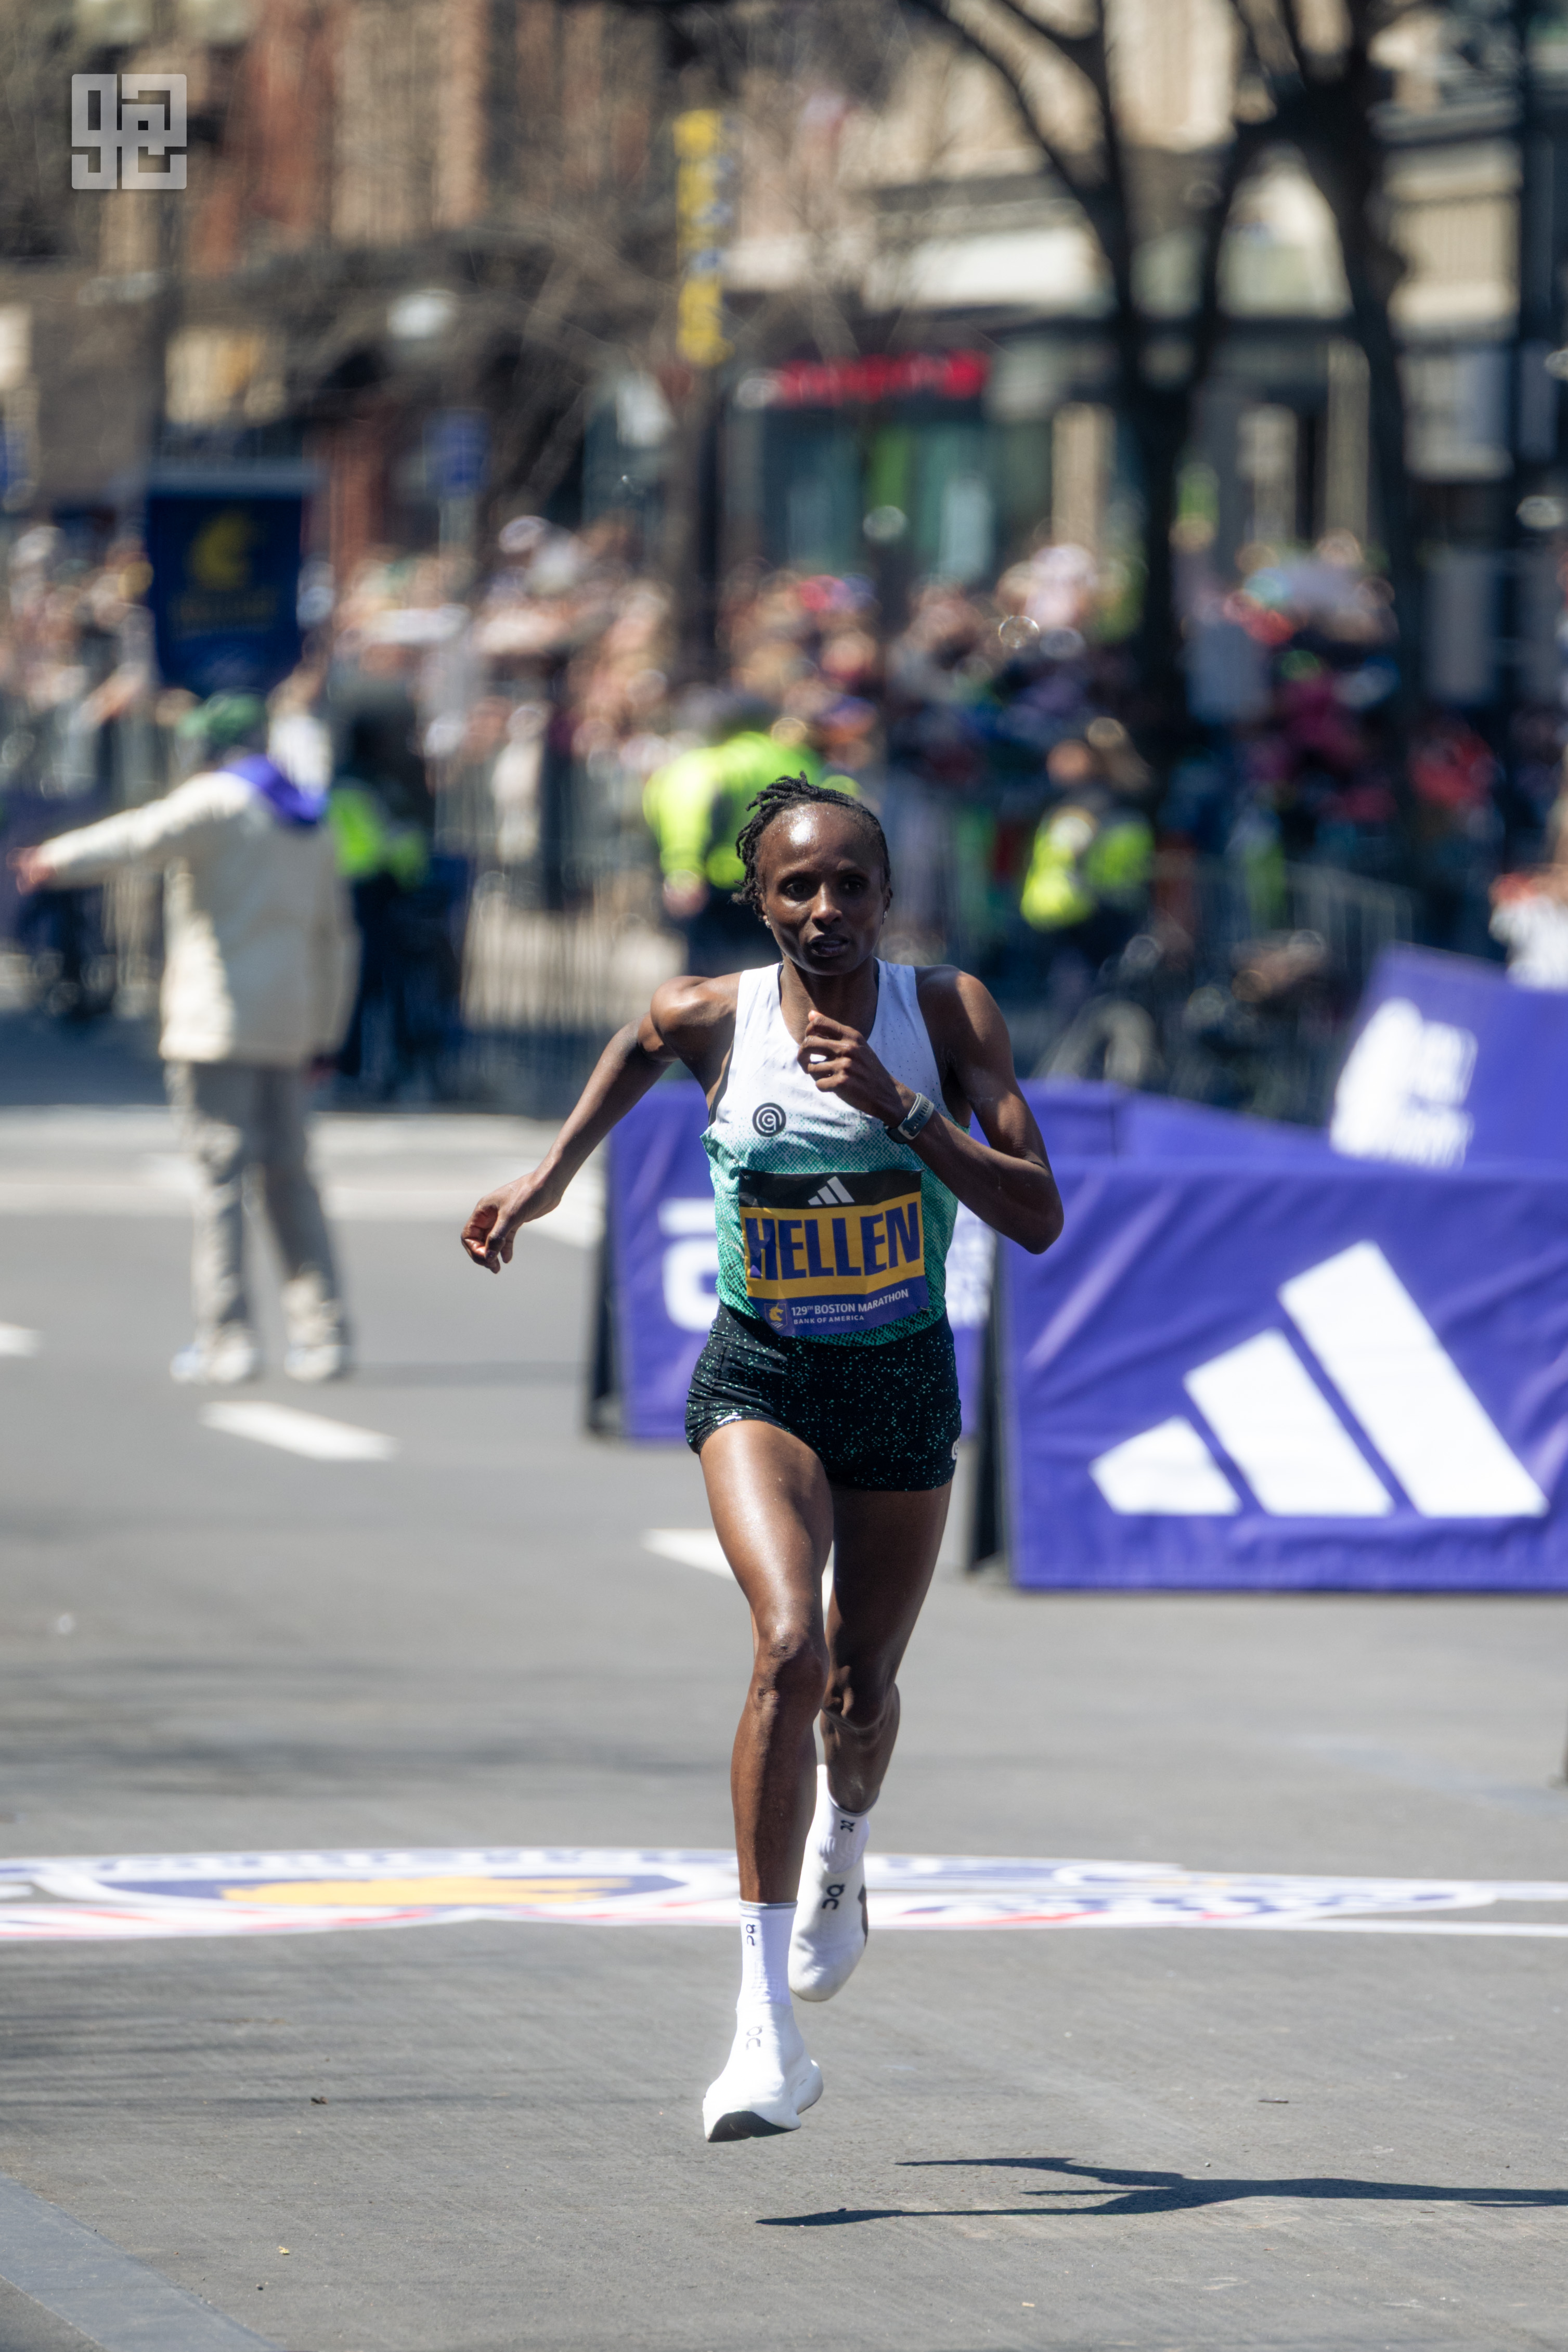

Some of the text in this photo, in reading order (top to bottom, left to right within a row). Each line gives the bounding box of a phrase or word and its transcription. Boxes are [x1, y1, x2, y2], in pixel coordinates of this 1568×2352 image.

[744, 1201, 921, 1281] HELLEN
[814, 1303, 856, 1315] BOSTON
[858, 1288, 909, 1312] MARATHON
